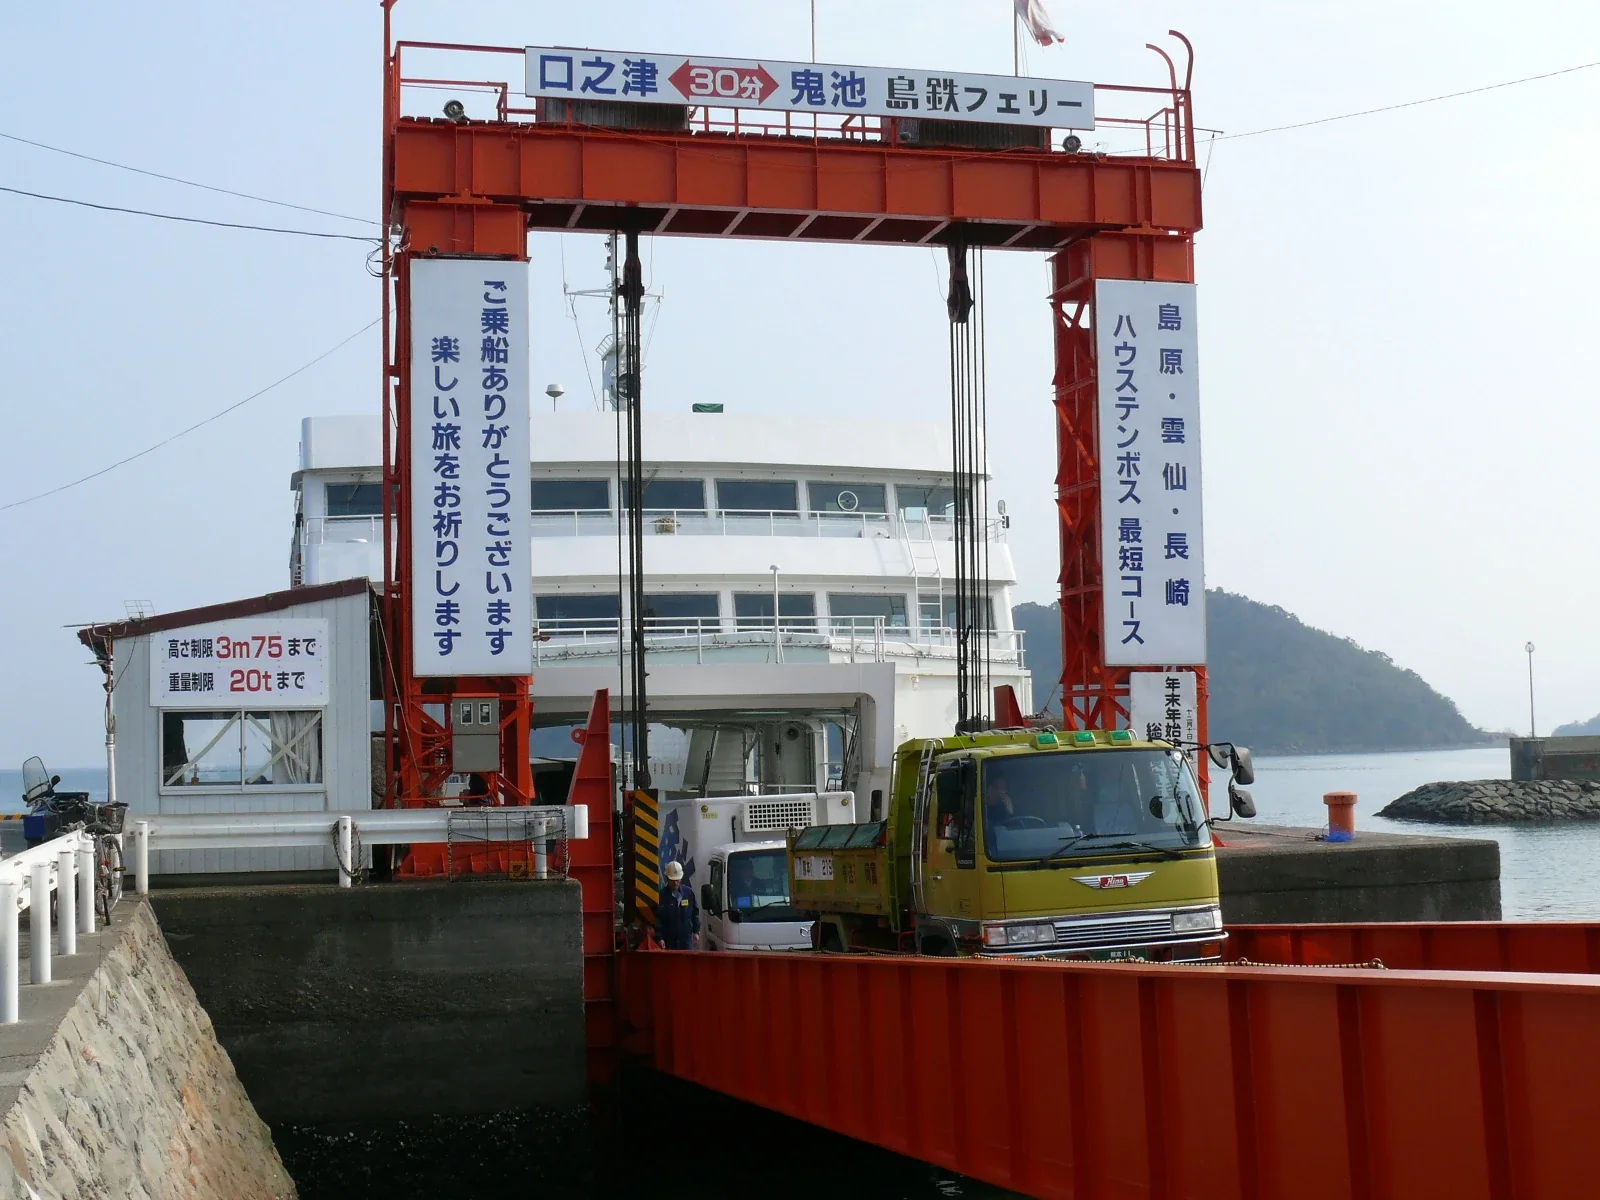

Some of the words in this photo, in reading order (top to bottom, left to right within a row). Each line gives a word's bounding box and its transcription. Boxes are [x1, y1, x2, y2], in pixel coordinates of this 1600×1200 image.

[538, 54, 659, 97] 口之津
[689, 67, 765, 99] 30分
[790, 70, 867, 108] 鬼池
[885, 75, 1083, 117] 島鉄フェリー
[1113, 314, 1142, 505] ハウステンボス
[431, 336, 463, 656] 楽しい旅をお祈りします
[480, 279, 513, 656] ご乗船ありがとうございます
[1118, 517, 1144, 645] 最短コース
[168, 638, 213, 659] 高さ制限
[216, 636, 283, 659] 3m75
[287, 637, 317, 657] まで
[169, 672, 214, 692] 重量制限
[230, 669, 272, 692] 20t
[277, 671, 305, 690] まで
[1165, 676, 1181, 746] 年末年始
